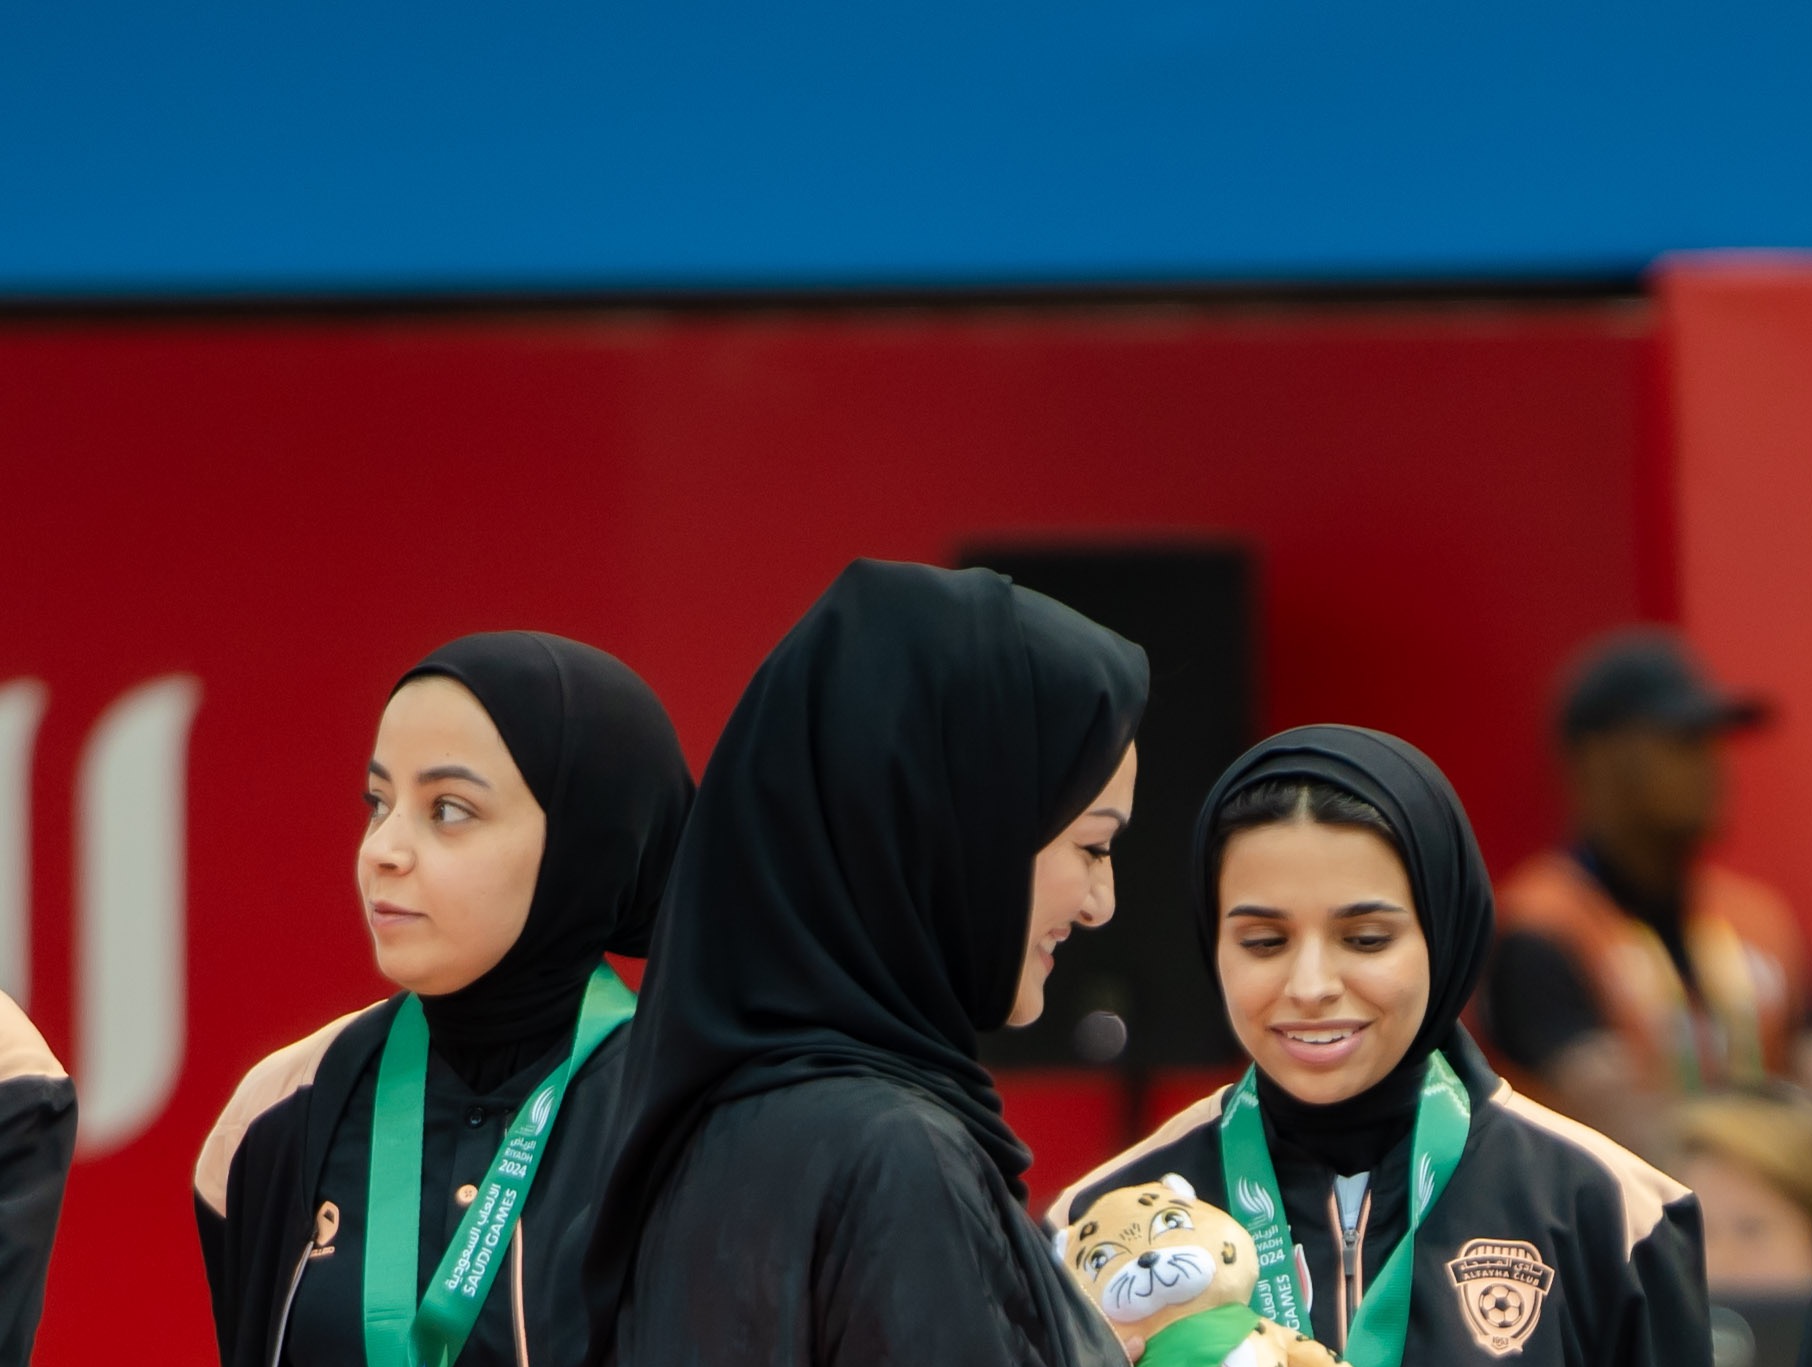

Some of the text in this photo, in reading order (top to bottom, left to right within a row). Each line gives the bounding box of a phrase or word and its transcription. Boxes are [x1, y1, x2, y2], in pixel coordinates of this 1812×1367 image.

[504, 1147, 534, 1164] RIYADH
[499, 1159, 528, 1178] 2024
[462, 1187, 518, 1298] SAUDI GAMES
[1256, 1236, 1284, 1252] YADH
[1259, 1248, 1286, 1267] 024
[1463, 1269, 1541, 1287] ALFAYHA CLUB
[1276, 1273, 1301, 1330] GAMES
